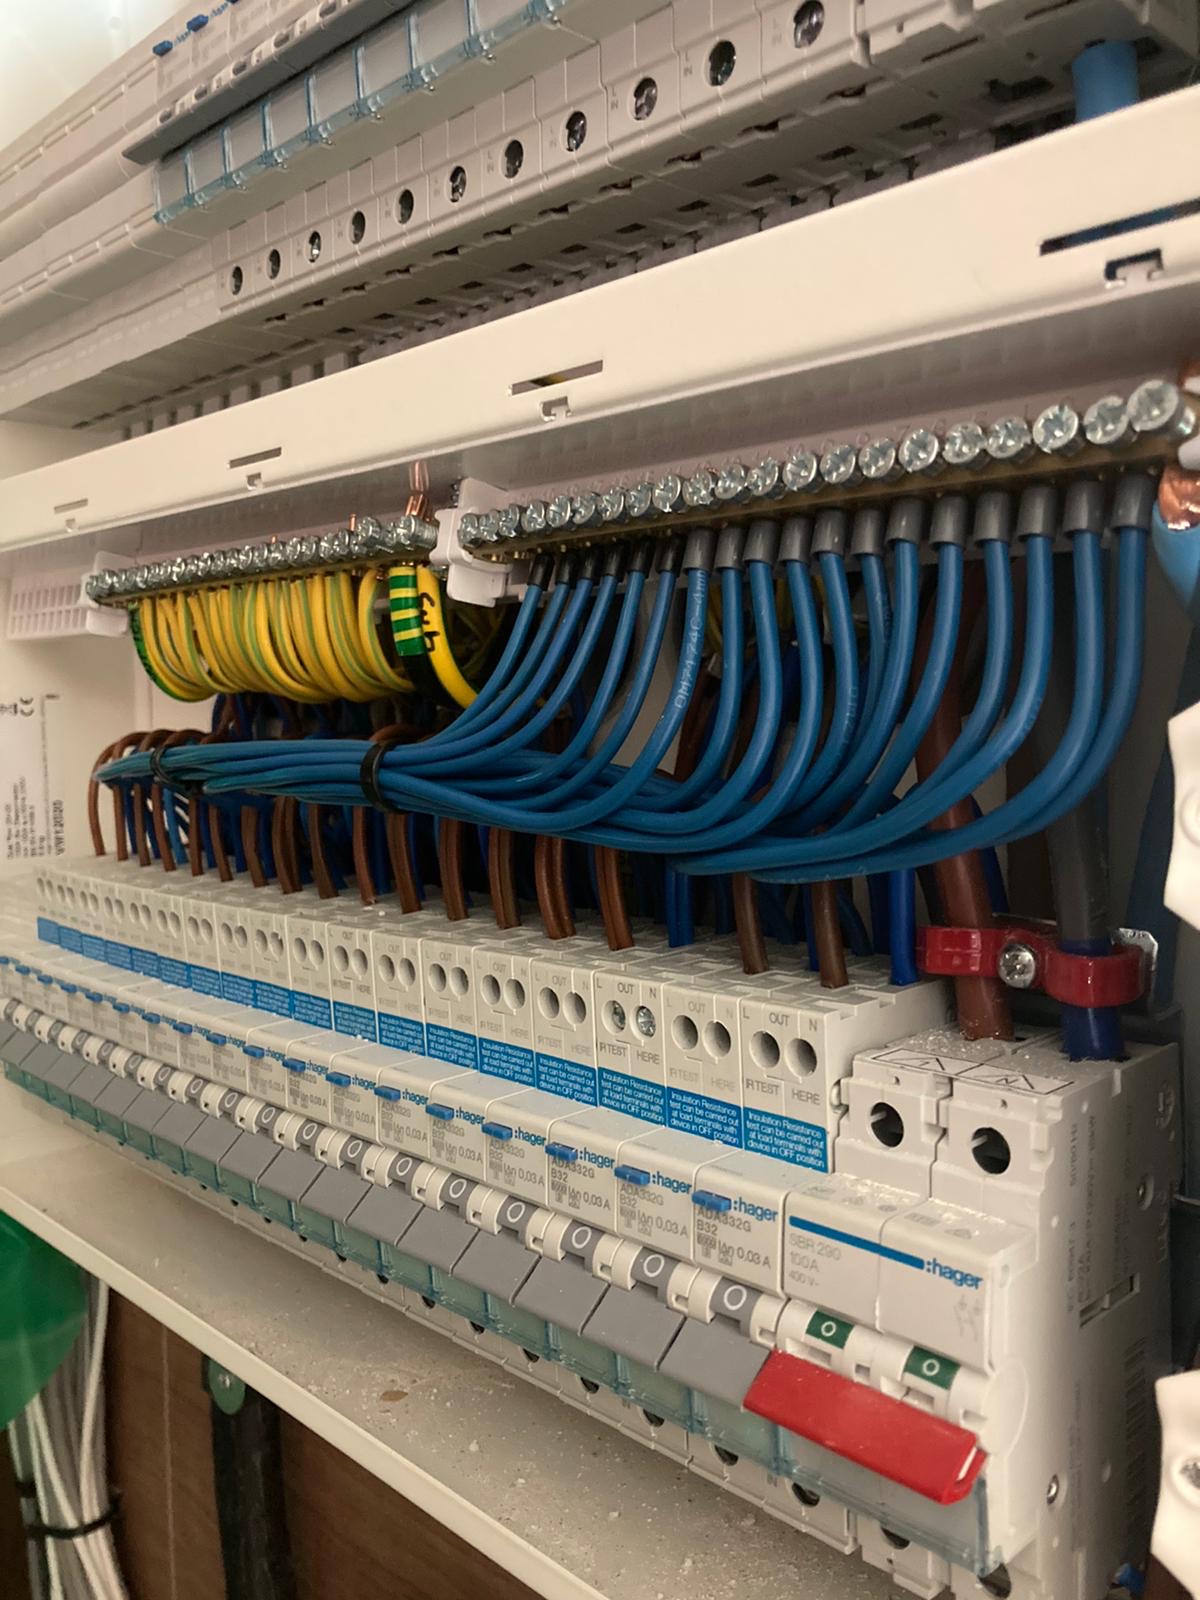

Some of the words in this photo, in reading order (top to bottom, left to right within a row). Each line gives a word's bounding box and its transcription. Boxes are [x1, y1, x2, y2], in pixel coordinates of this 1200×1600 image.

[617, 982, 634, 995] OUT
[769, 1012, 790, 1026] OUT
[756, 1080, 780, 1096] TEST
[792, 1087, 821, 1106] HERE
[551, 1168, 568, 1182] B32
[697, 1219, 718, 1235] B32
